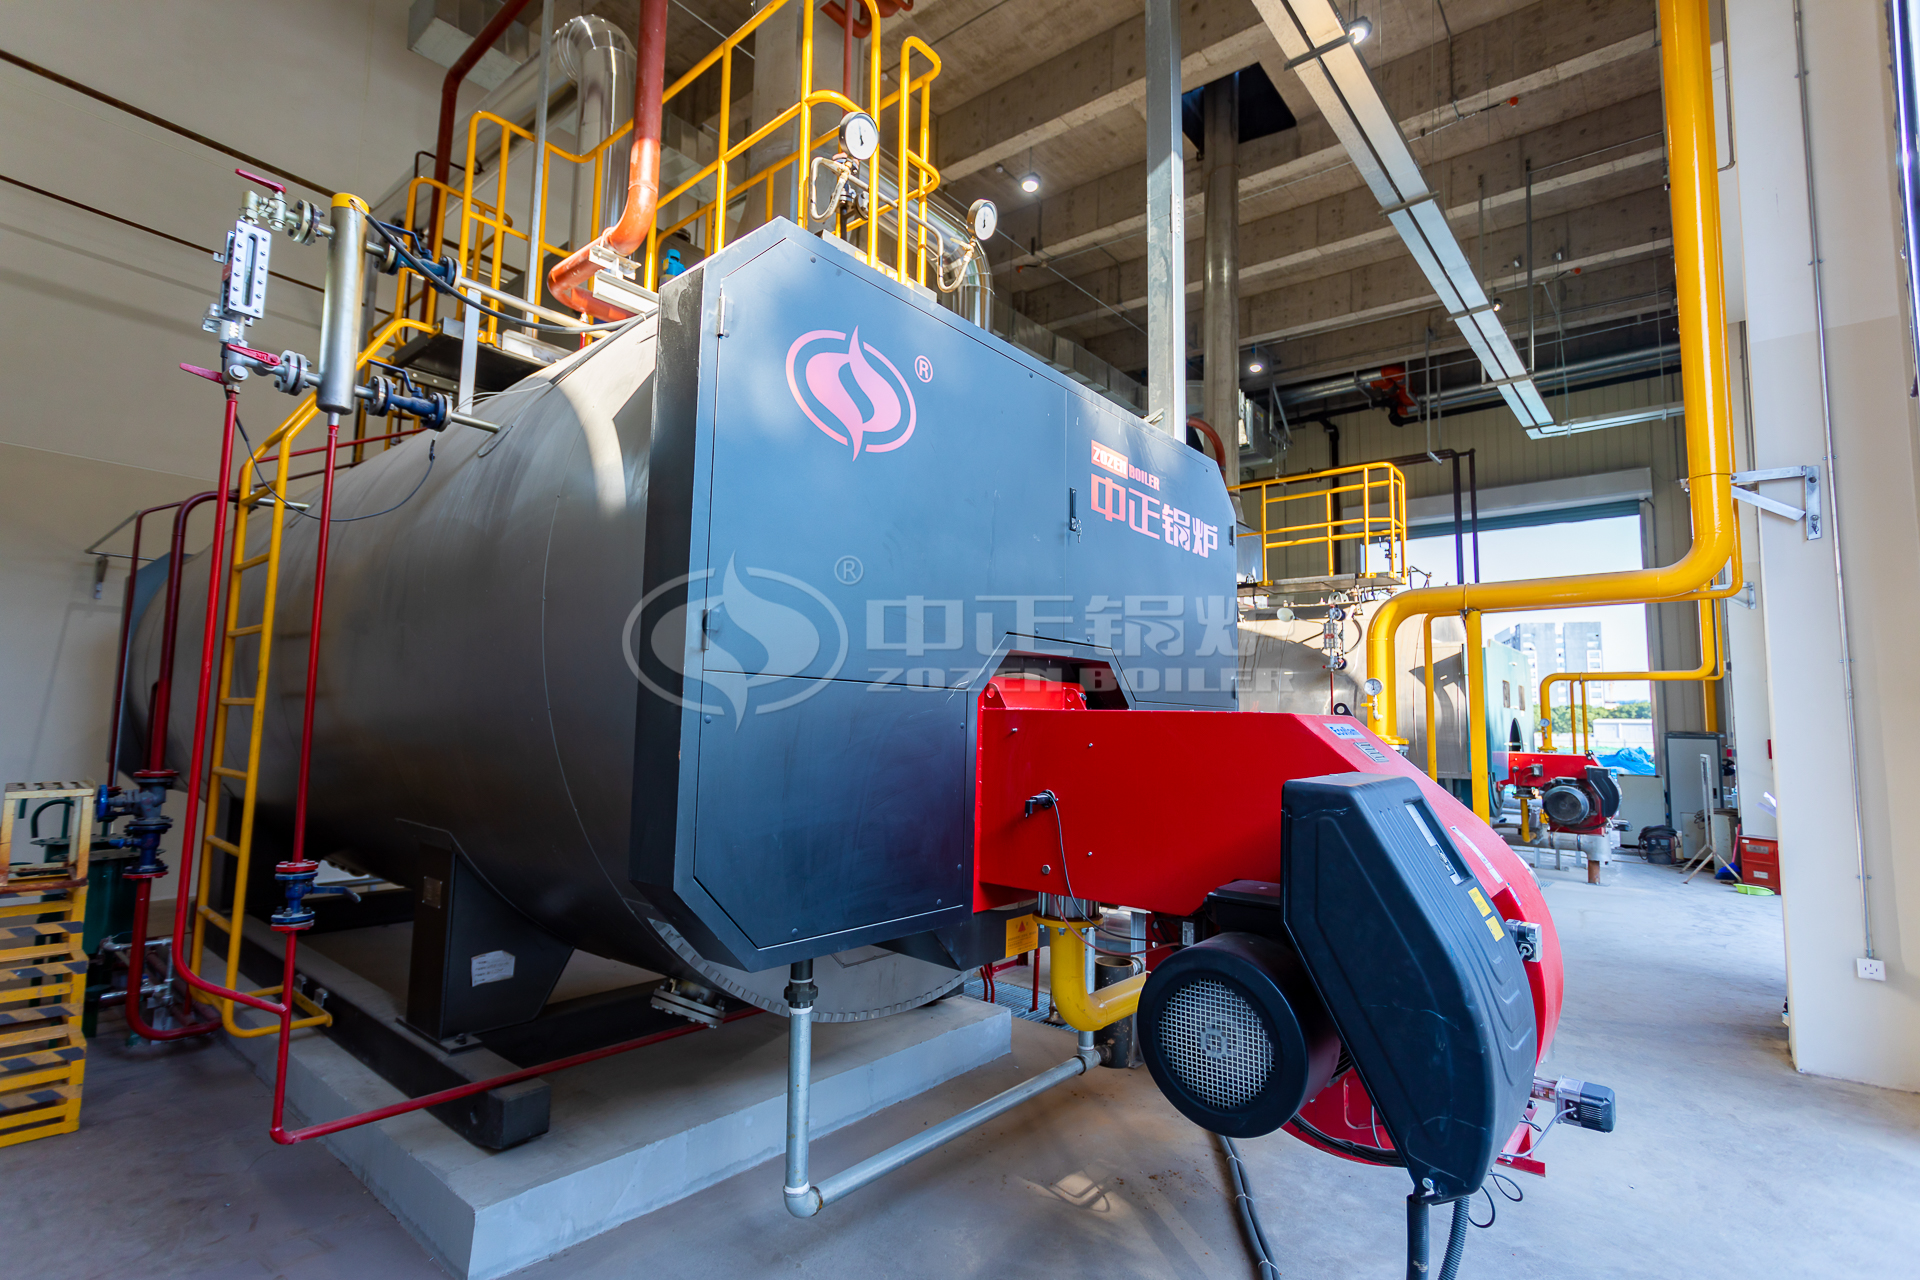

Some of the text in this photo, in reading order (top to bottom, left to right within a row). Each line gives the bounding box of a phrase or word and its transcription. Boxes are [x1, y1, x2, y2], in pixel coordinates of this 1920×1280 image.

[1092, 445, 1160, 492] ZOZEN BOILER
[1091, 473, 1218, 558] 中正锅炉
